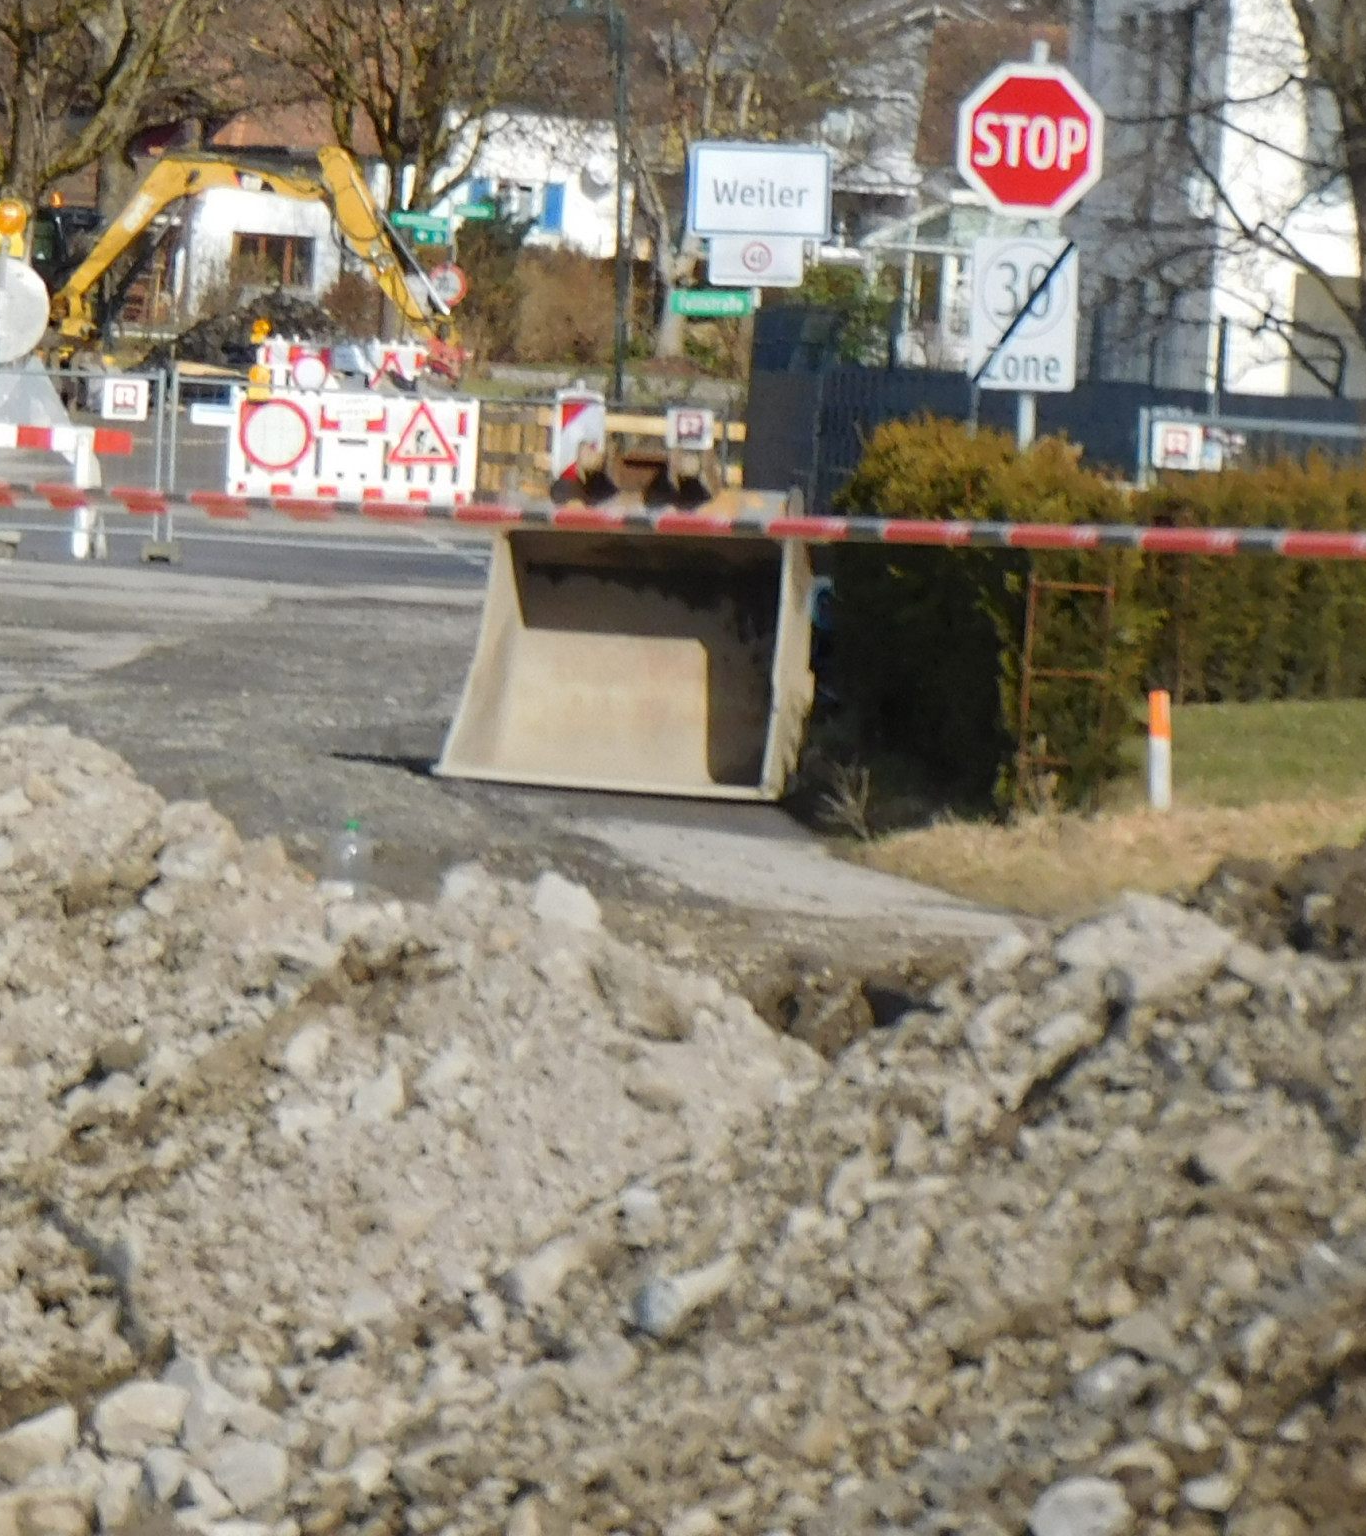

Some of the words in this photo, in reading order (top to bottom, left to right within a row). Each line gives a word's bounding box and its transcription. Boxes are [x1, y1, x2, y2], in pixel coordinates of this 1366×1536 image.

[973, 112, 1087, 171] STOP
[712, 177, 809, 208] Weiler
[994, 261, 1050, 318] 30
